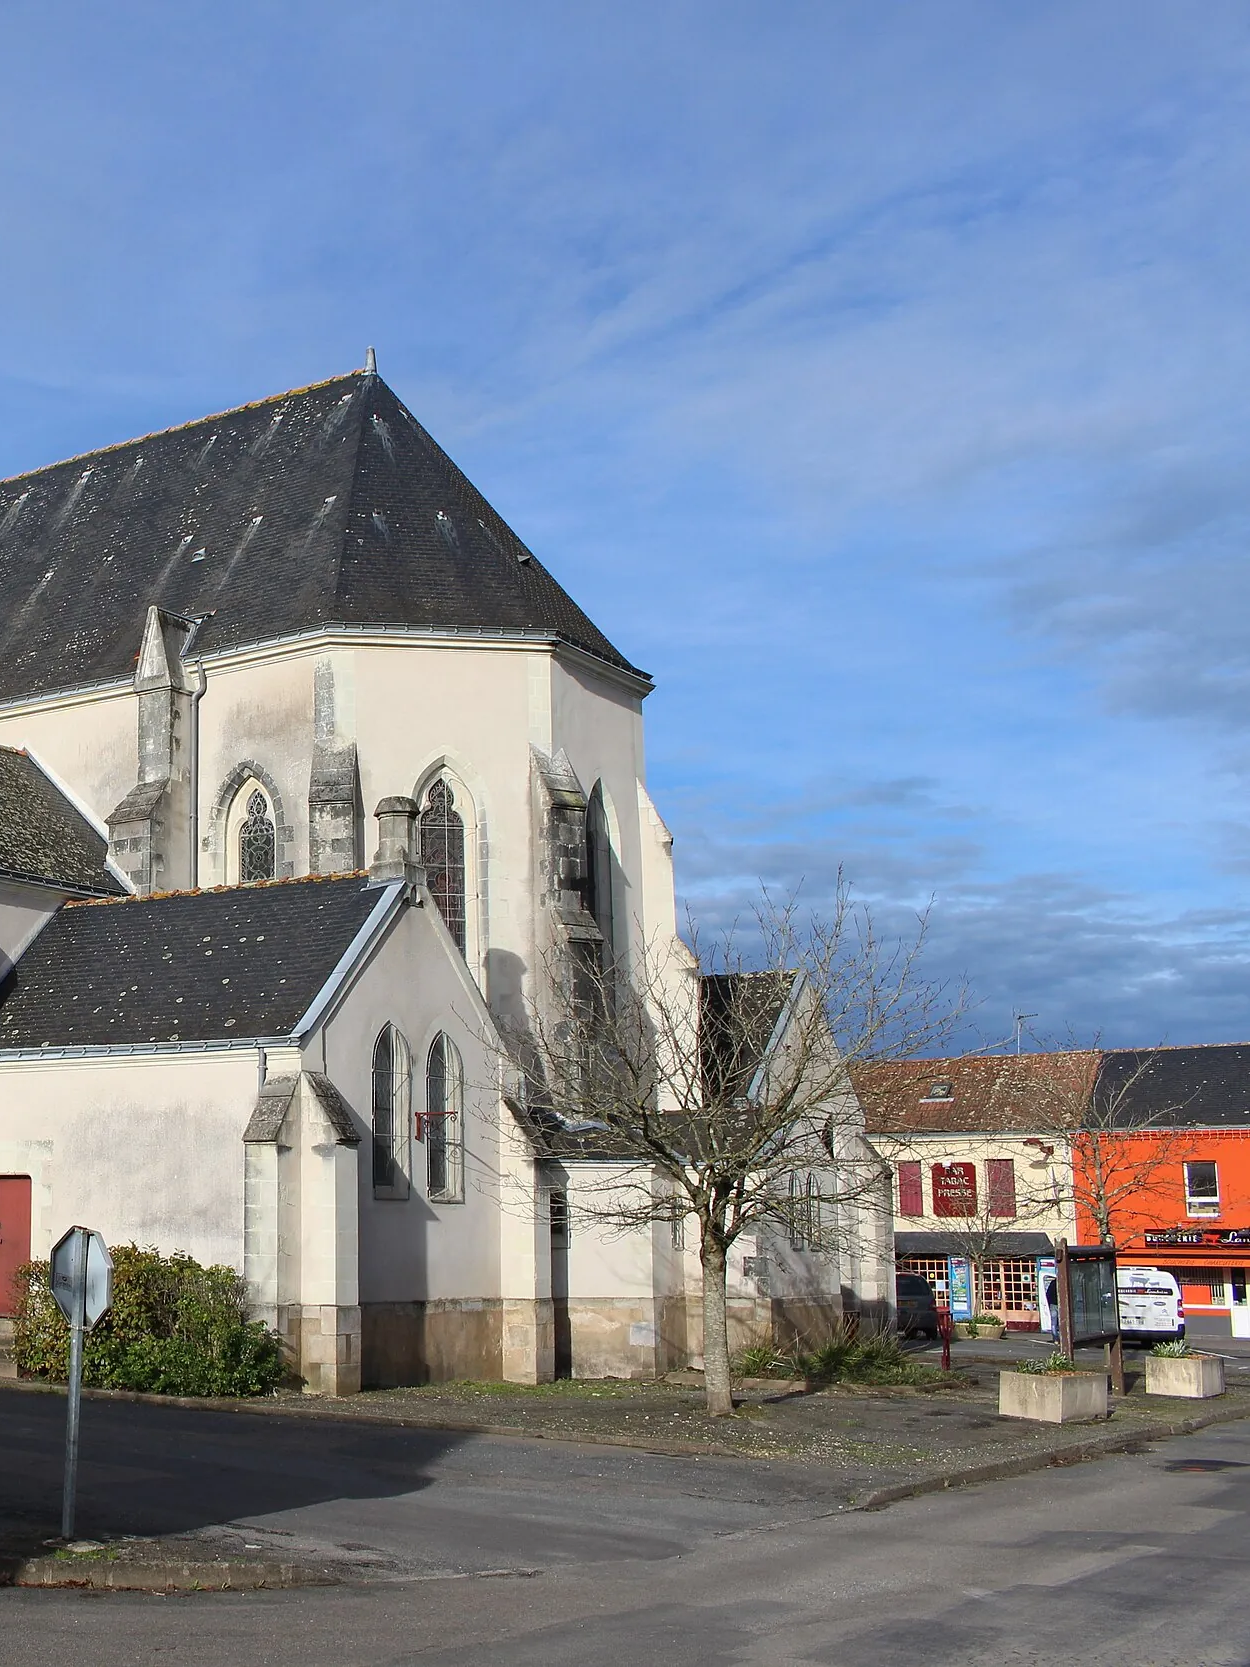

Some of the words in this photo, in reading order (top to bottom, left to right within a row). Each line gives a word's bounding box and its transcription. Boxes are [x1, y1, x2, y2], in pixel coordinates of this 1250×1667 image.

[945, 1167, 964, 1175] BAR
[940, 1177, 970, 1185] TABAC
[937, 1188, 972, 1197] PRESSE
